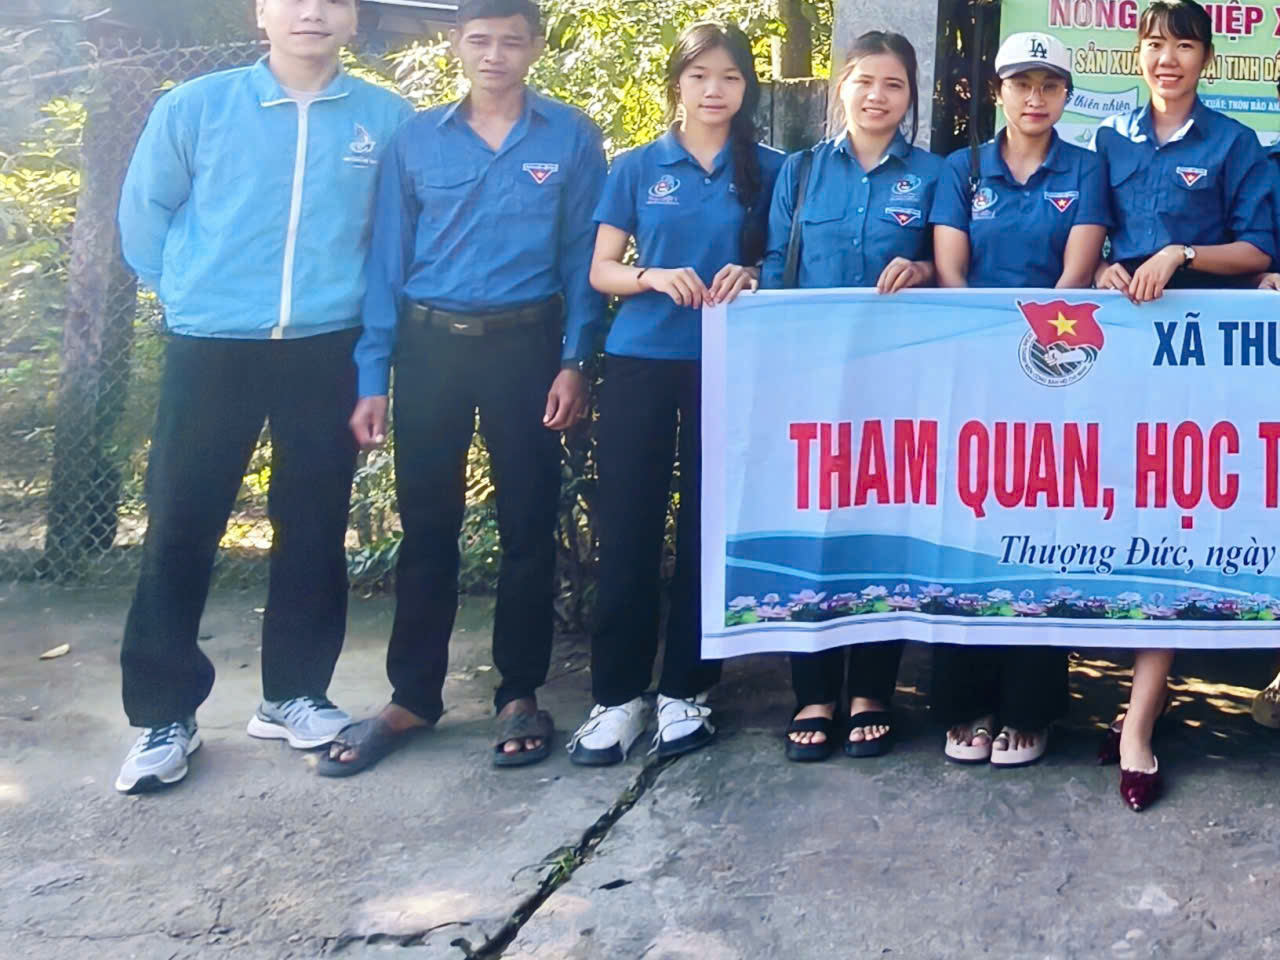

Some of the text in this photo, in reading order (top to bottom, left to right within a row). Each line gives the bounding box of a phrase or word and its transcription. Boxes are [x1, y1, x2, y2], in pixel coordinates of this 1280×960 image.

[1029, 38, 1047, 59] LA
[1075, 41, 1108, 75] SẢN
[1110, 46, 1143, 75] XUẤ
[1225, 55, 1260, 81] TINH
[1074, 95, 1130, 111] thiên nhiên
[1153, 312, 1206, 366] XÃ
[789, 420, 938, 510] THAM
[958, 421, 1115, 520] QUAN,
[1135, 421, 1239, 529] HỌC
[1001, 535, 1116, 574] Thượng
[1126, 536, 1194, 569] Đức,
[1206, 536, 1276, 575] ngày
